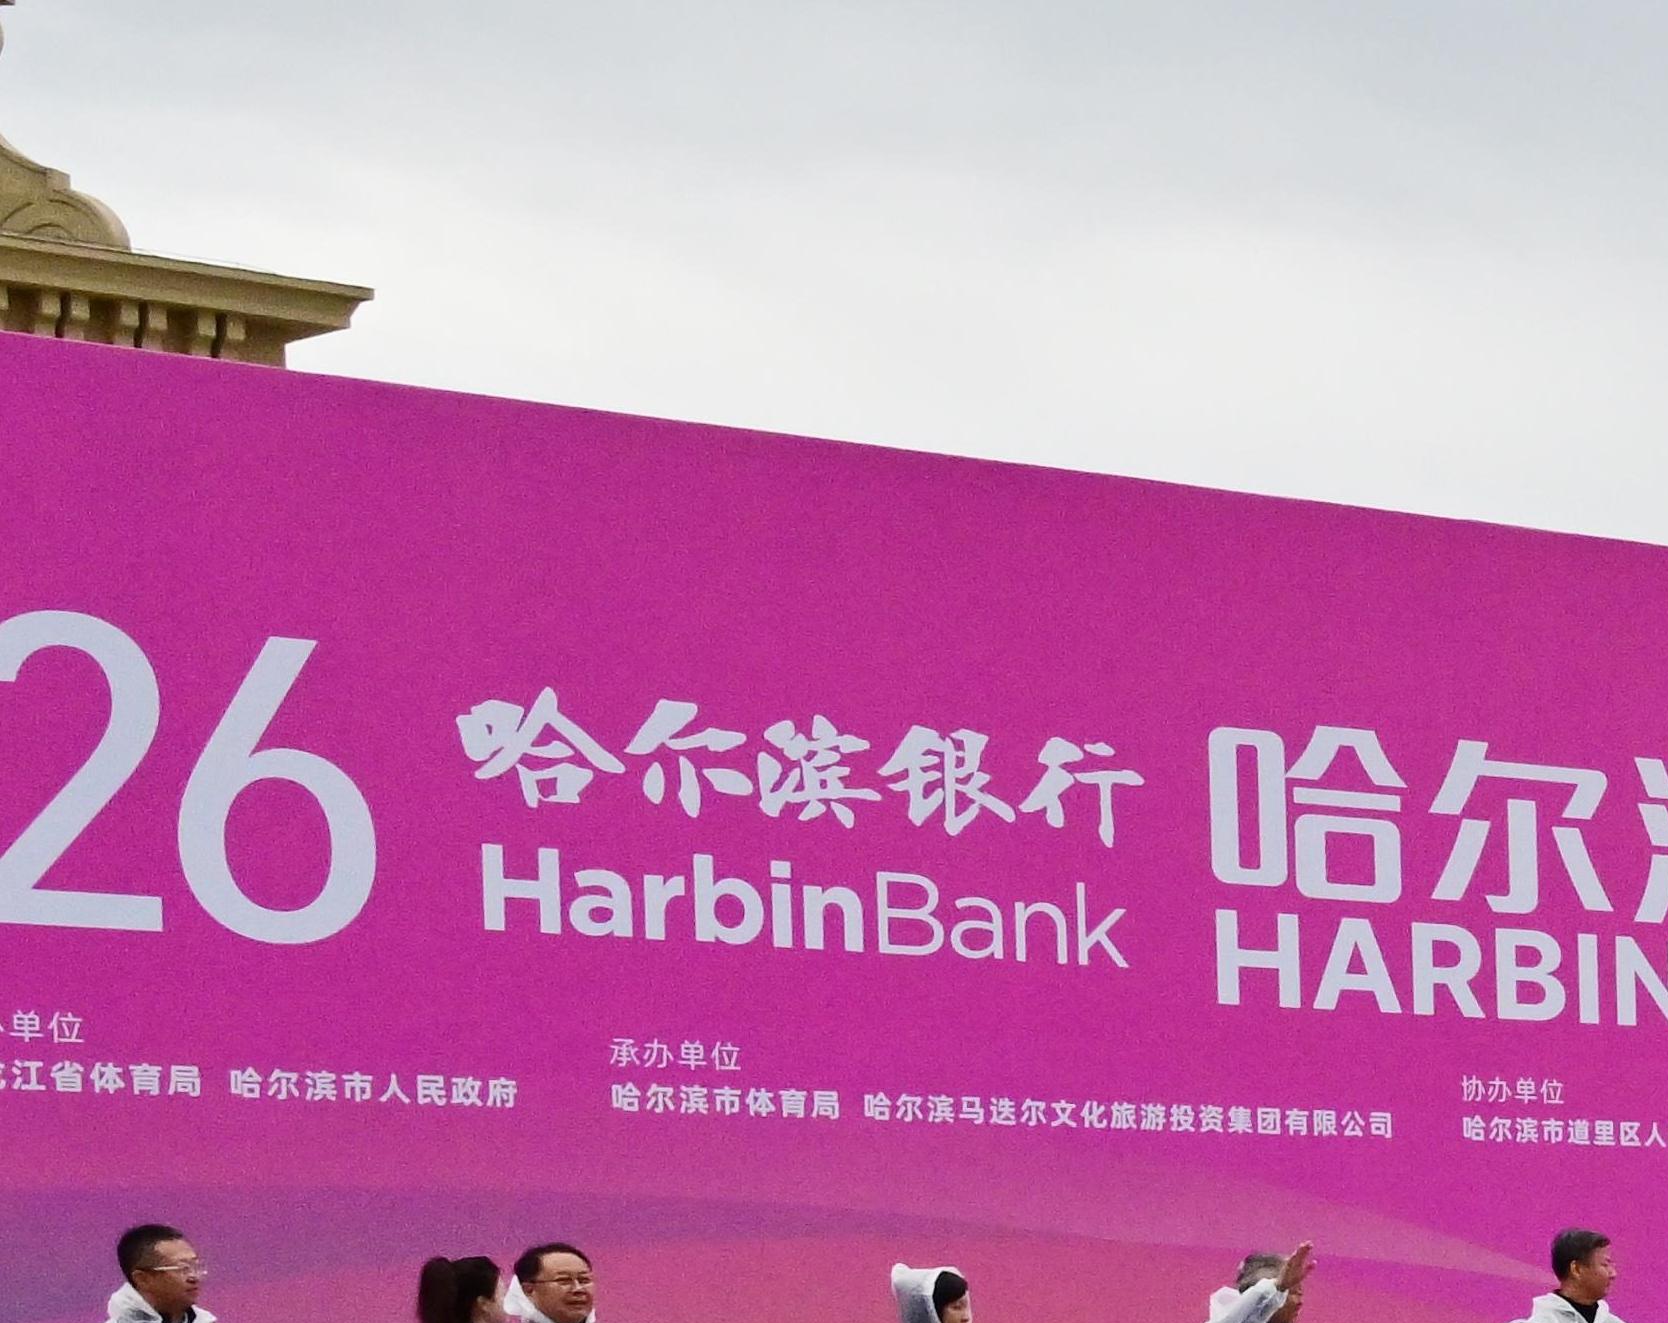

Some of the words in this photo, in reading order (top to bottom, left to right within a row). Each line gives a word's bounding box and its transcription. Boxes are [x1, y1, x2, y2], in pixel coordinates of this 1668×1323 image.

[455, 686, 1144, 850] 哈尔滨银行
[480, 843, 1130, 969] HarbinBank
[0, 1010, 86, 1044] 单位
[609, 1038, 742, 1073] 承办单位
[229, 1067, 518, 1110] 哈尔滨市人民政府
[1461, 1075, 1565, 1106] 协办单位
[610, 1083, 841, 1121] 哈尔滨市体育局
[864, 1092, 1395, 1140] 哈尔滨马迭尔文化旅游投资集团有限公司
